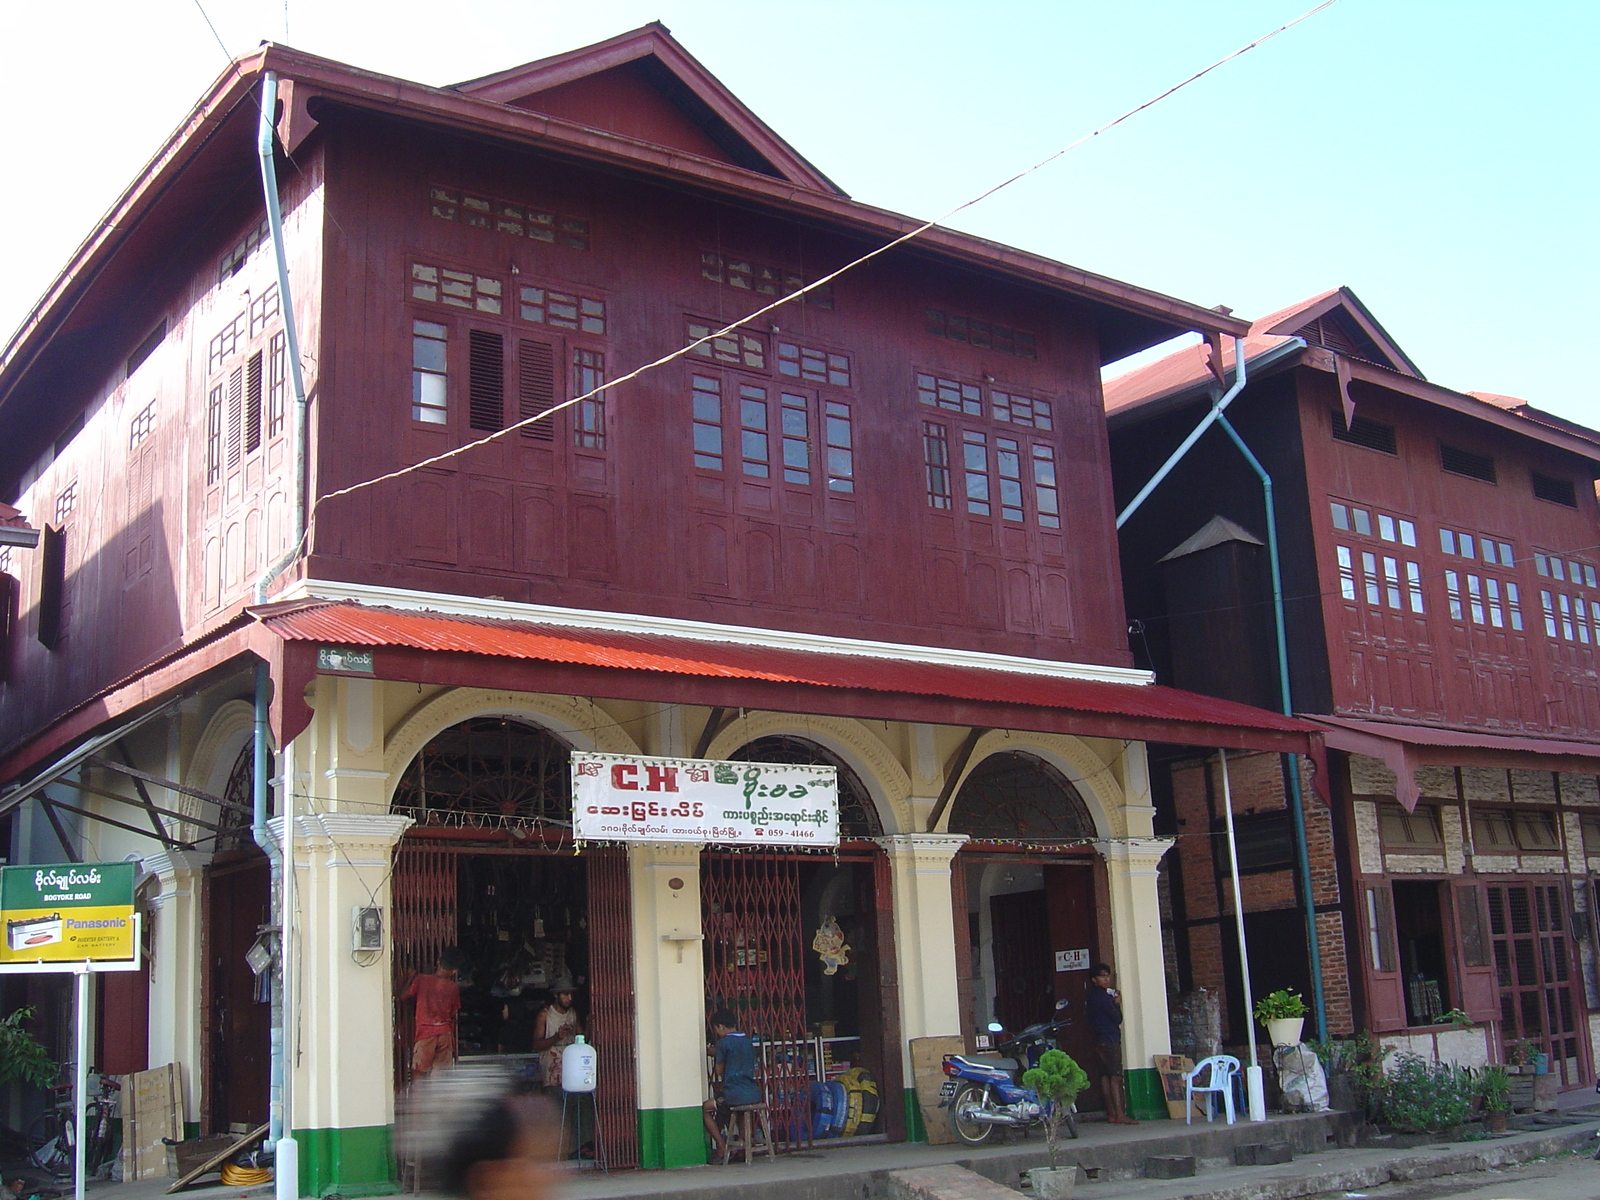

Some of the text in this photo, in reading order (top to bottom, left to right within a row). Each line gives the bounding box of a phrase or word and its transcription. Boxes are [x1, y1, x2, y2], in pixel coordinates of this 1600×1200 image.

[611, 764, 679, 792] C.H
[587, 801, 704, 821] ဆေးပြင်းလိပ်
[722, 806, 829, 827] ကားပစ္စည်းအရောင်းဆိုင်
[768, 829, 784, 837] 059
[790, 830, 815, 838] 41466
[35, 868, 101, 891] ဗိုလ်ချုပ်လမ်း
[66, 917, 126, 929] Panasonic
